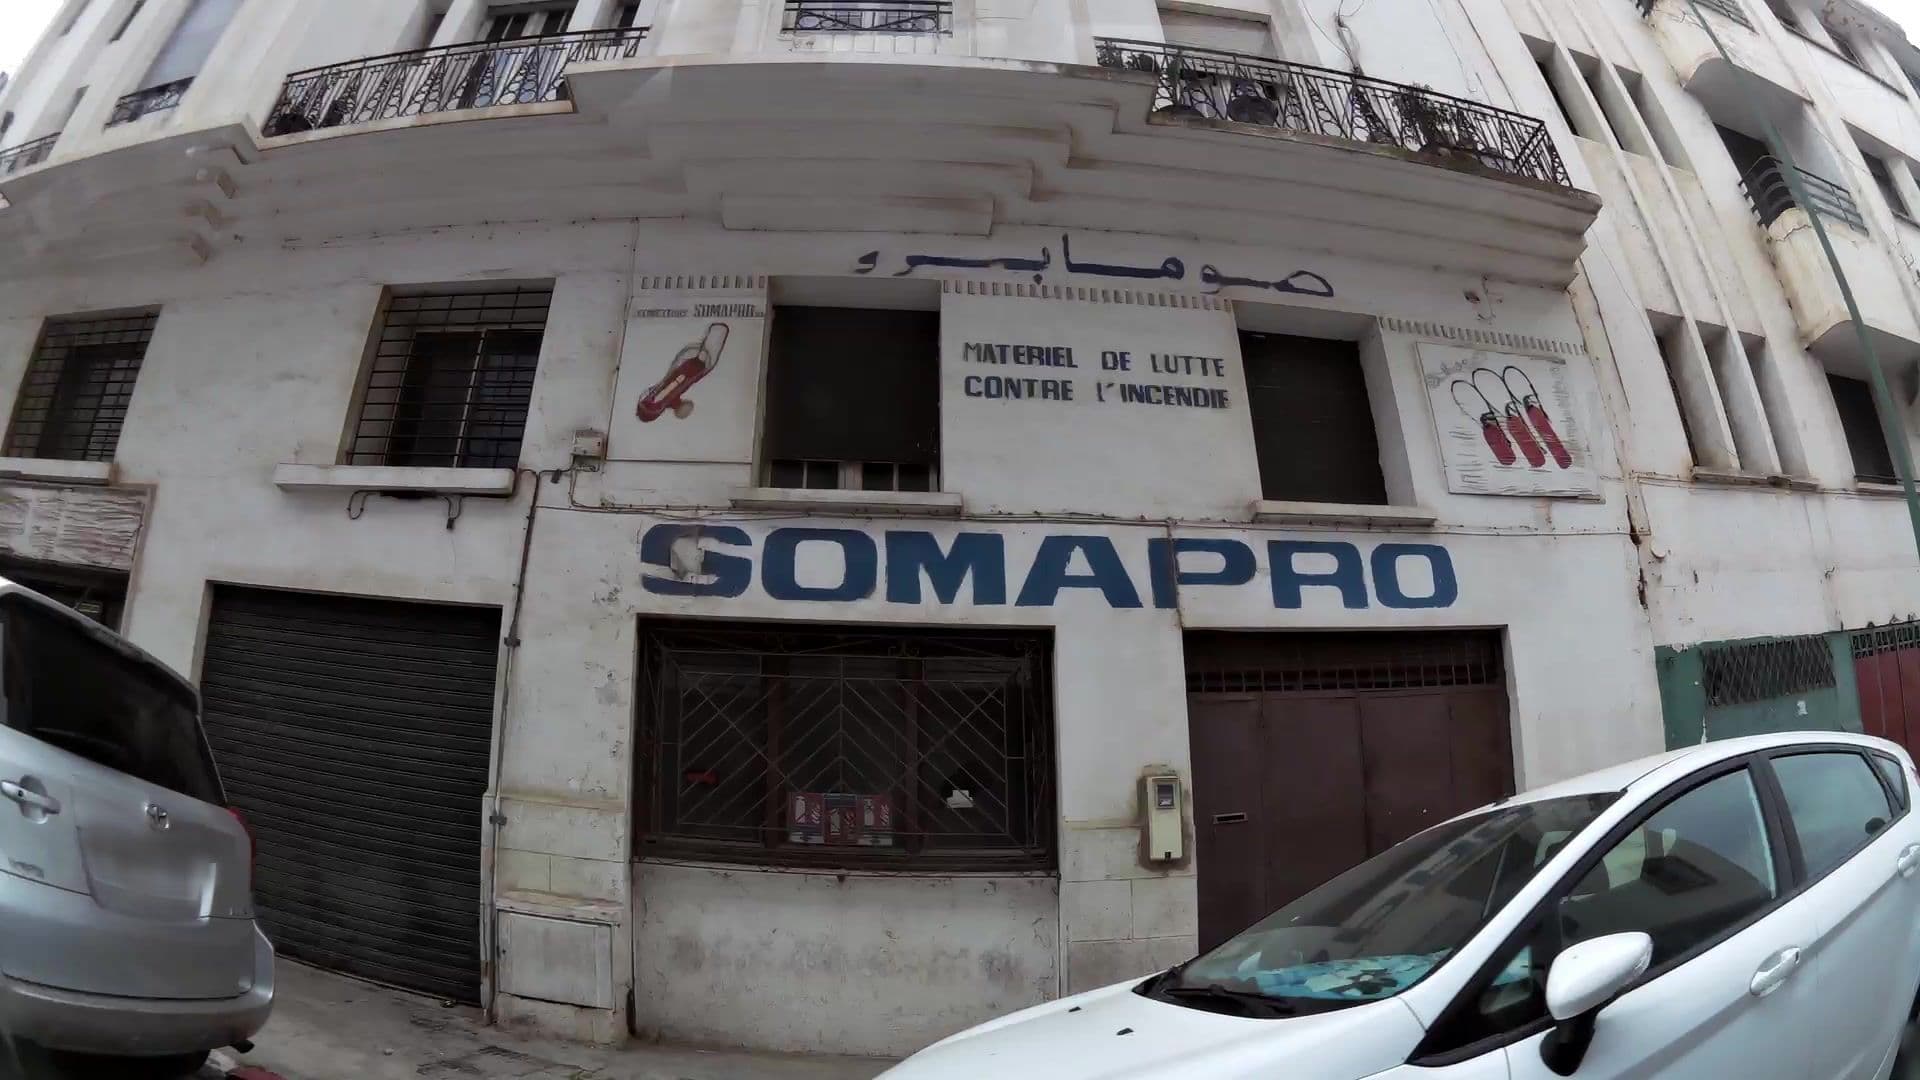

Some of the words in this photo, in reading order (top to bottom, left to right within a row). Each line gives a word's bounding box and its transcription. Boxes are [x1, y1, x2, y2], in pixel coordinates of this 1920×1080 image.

[963, 342, 1078, 368] MATERIEL
[1100, 351, 1131, 371] DE
[1150, 353, 1225, 377] LUTTE
[964, 375, 1073, 401] CONTRE
[1096, 382, 1229, 409] L'INCENDIE
[641, 524, 1459, 609] SOMAPRO
